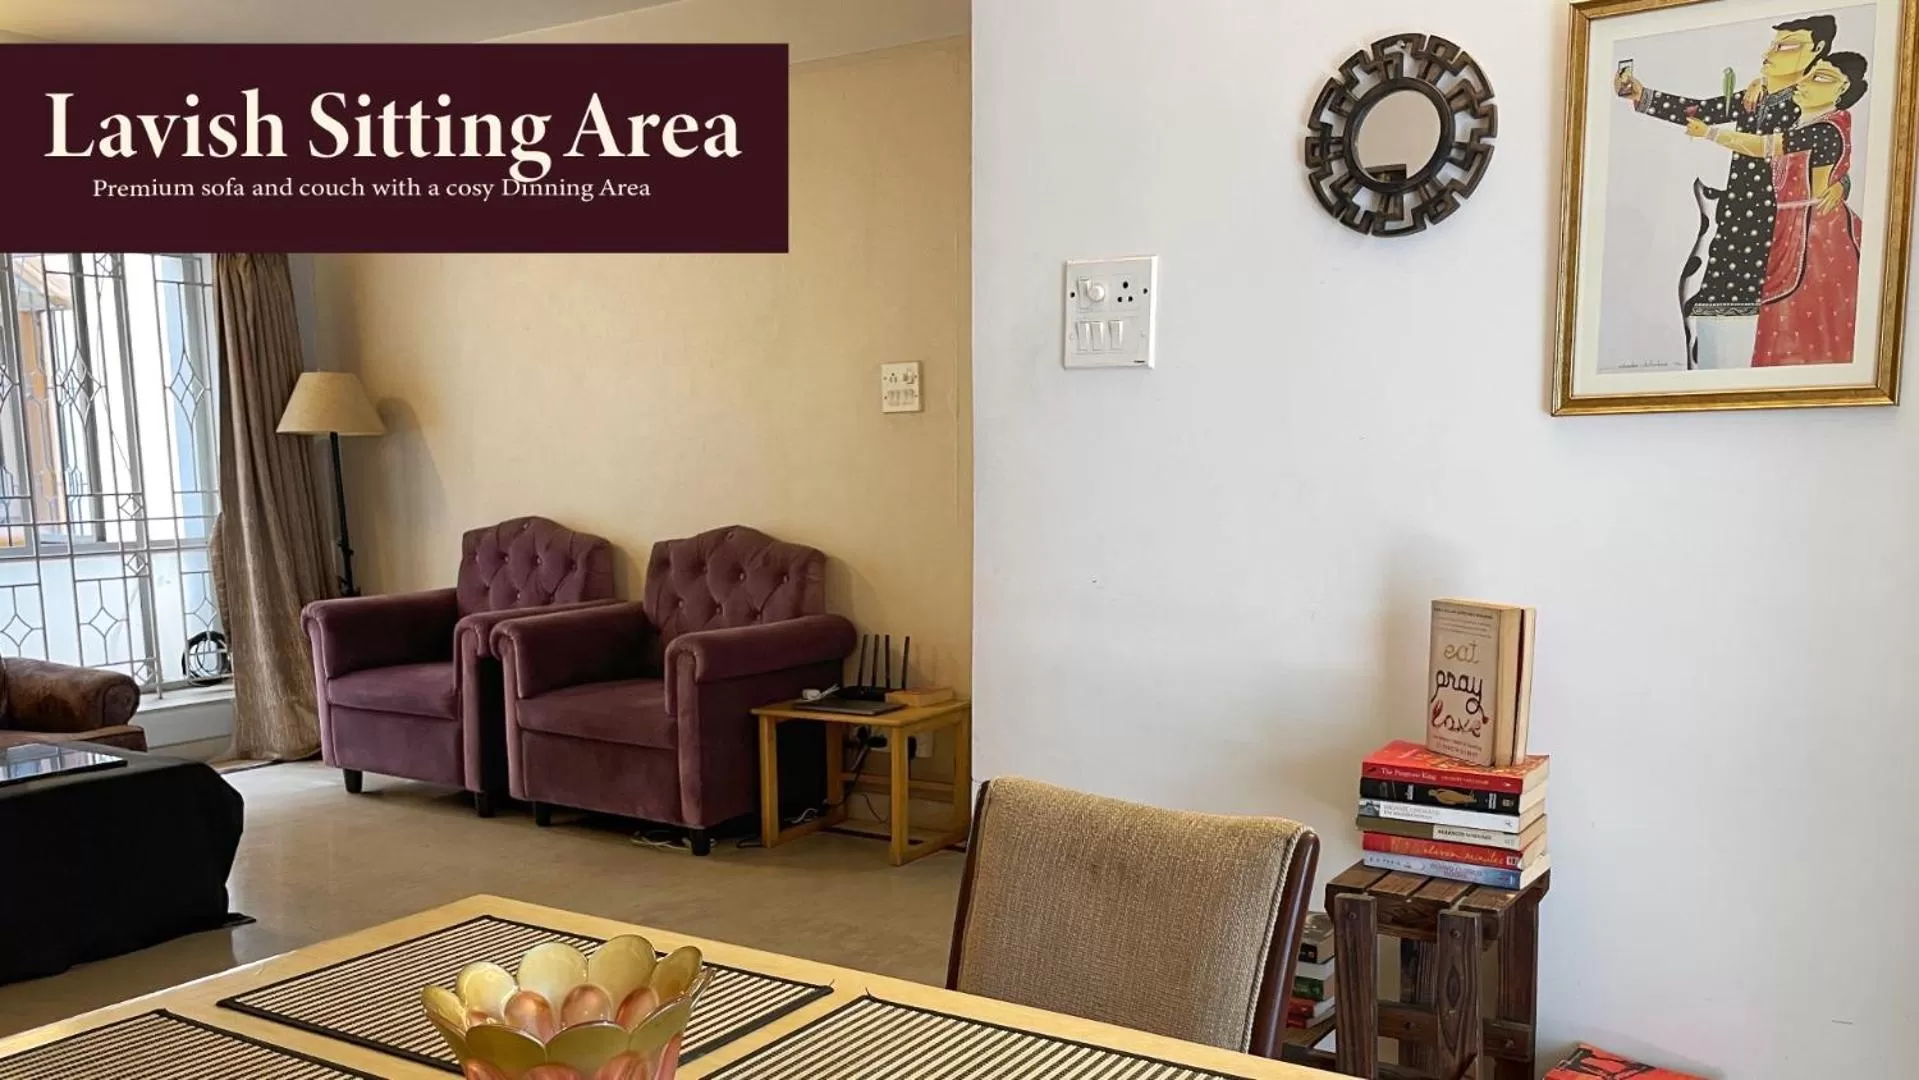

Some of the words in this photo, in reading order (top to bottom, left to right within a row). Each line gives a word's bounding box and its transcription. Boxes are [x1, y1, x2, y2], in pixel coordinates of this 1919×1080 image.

[1443, 640, 1480, 664] eat
[1431, 669, 1487, 718] pray
[1431, 700, 1481, 737] love
